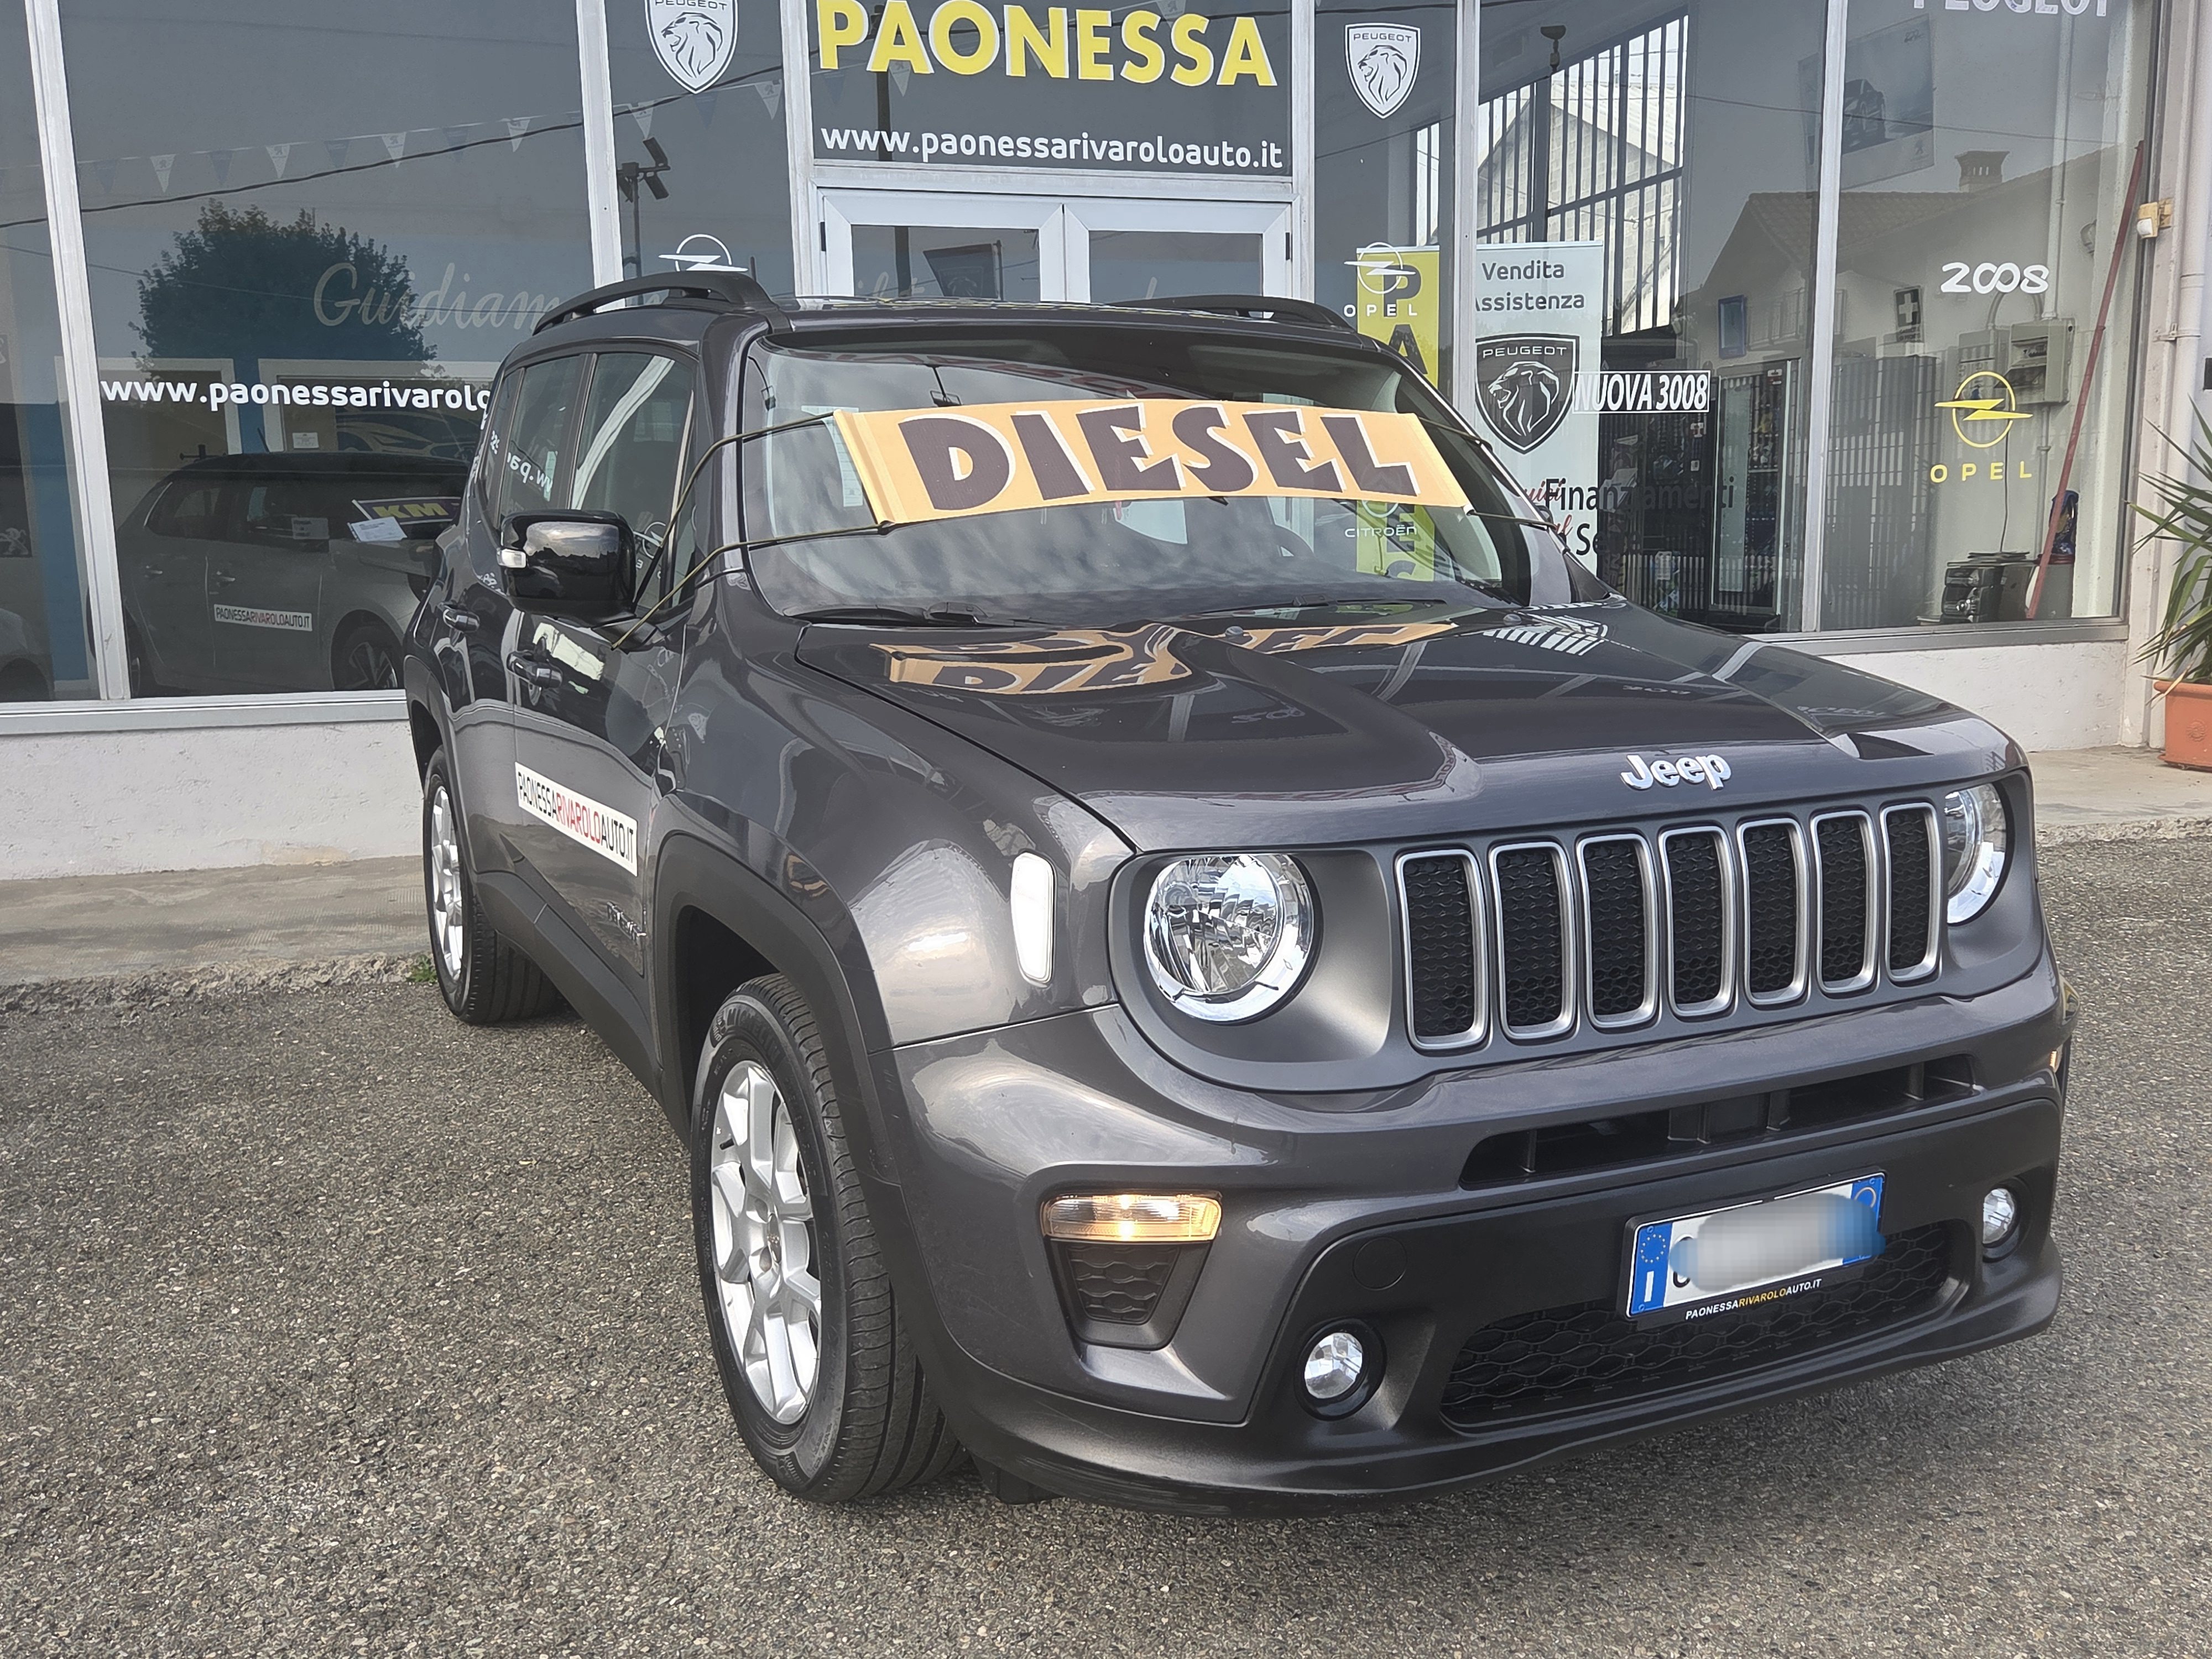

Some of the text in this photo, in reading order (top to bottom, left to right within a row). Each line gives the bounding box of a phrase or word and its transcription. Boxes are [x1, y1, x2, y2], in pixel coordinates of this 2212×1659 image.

[816, 0, 1278, 87] PAONESSA
[1353, 32, 1412, 43] PEUGEOT
[820, 127, 1283, 169] www.paonessarivaroloauto.it
[1481, 261, 1565, 281] Vendita
[1940, 262, 2049, 294] 2008
[1344, 304, 1417, 317] OPEL
[1482, 345, 1567, 358] PEUGEOT
[1574, 373, 1708, 411] NUOVA 3008
[898, 402, 1421, 510] DIESEL
[1930, 461, 2032, 483] OPEL
[372, 503, 449, 518] KM
[1621, 753, 1731, 790] Jeep
[518, 770, 635, 864] PAONESSARIVAROLOAUTO.IT
[1686, 1279, 1822, 1320] PAONESSARIVAROLOAUTO.IT
